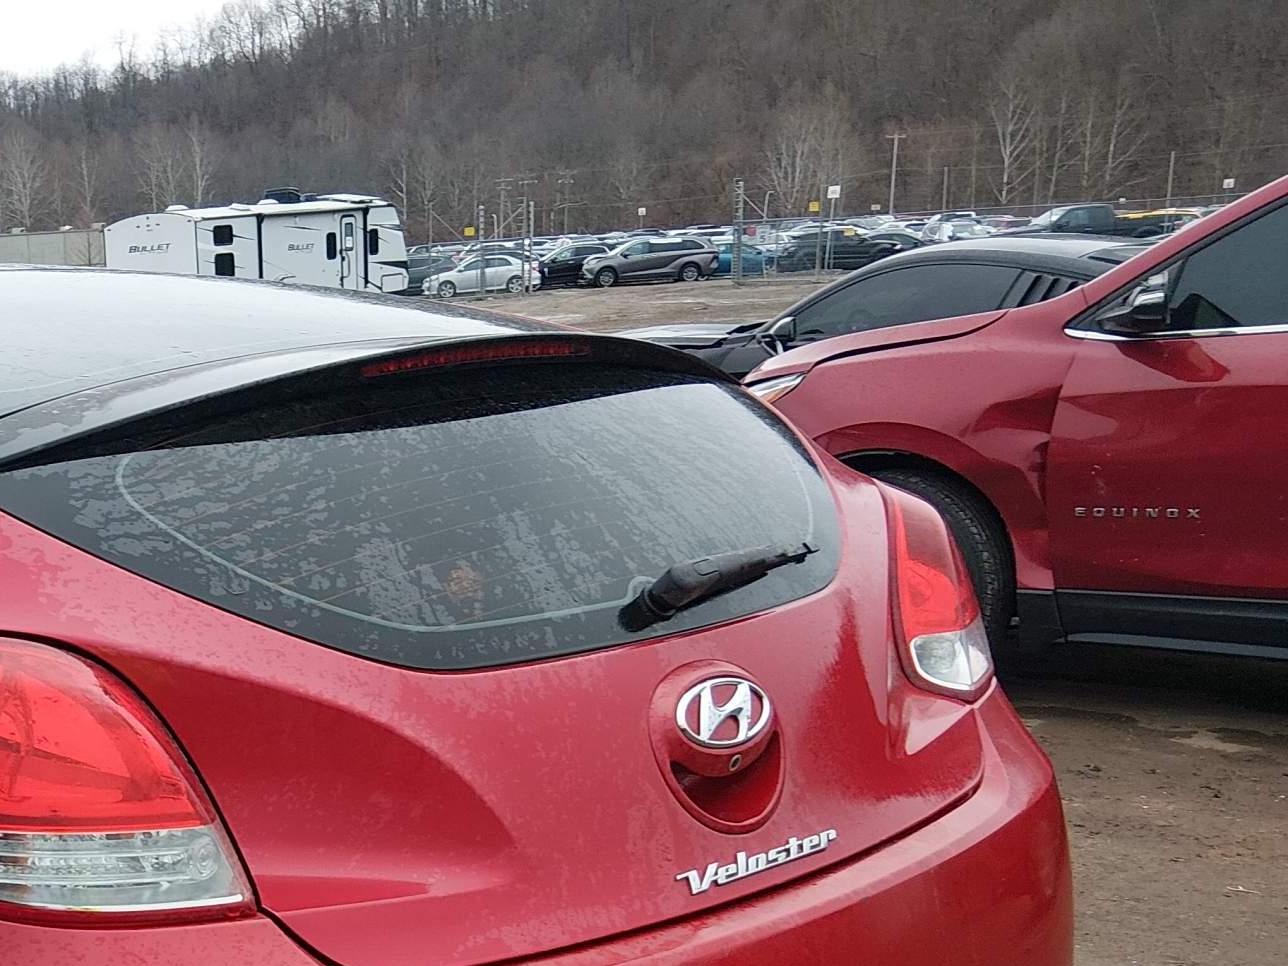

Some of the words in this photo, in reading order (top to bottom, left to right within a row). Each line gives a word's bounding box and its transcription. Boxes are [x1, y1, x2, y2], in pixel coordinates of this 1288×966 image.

[128, 243, 171, 254] BULLET
[1074, 507, 1200, 518] EQUINOX
[675, 829, 838, 895] Veloster
